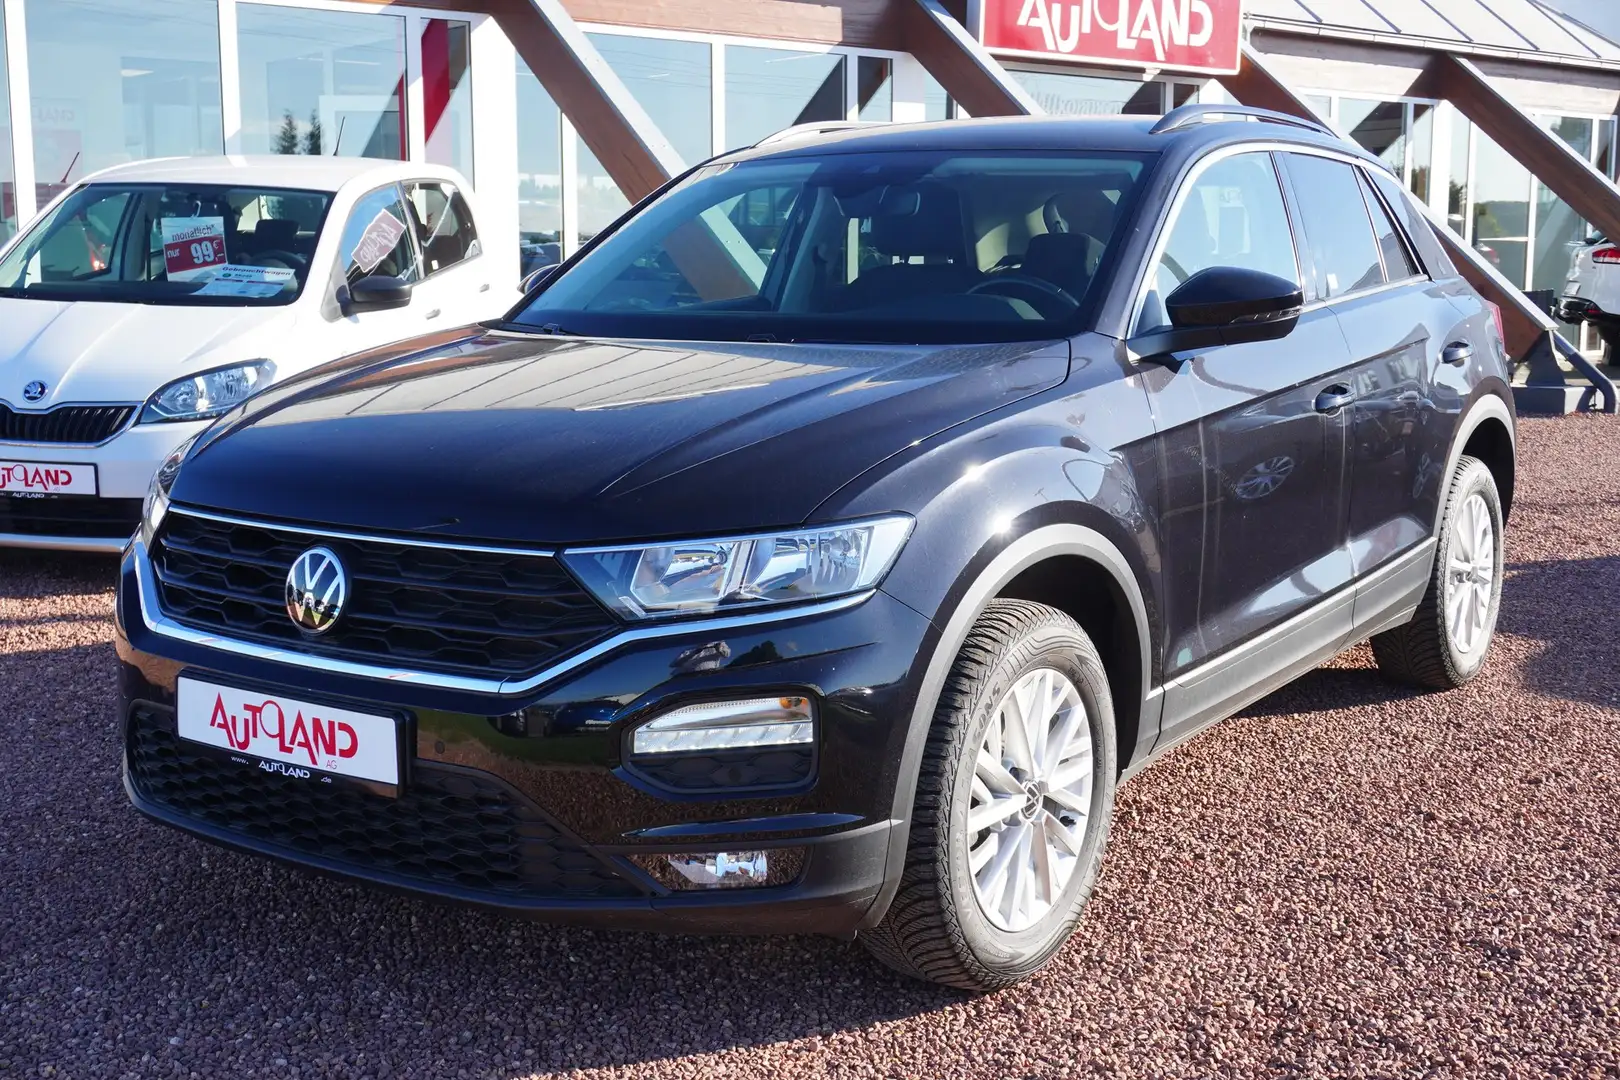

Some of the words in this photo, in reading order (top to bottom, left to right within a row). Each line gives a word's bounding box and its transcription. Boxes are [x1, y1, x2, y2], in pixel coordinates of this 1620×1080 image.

[167, 248, 180, 258] nur
[209, 692, 359, 766] AUTOLAND
[258, 760, 311, 779] AUTOLAND
[326, 759, 338, 770] AG
